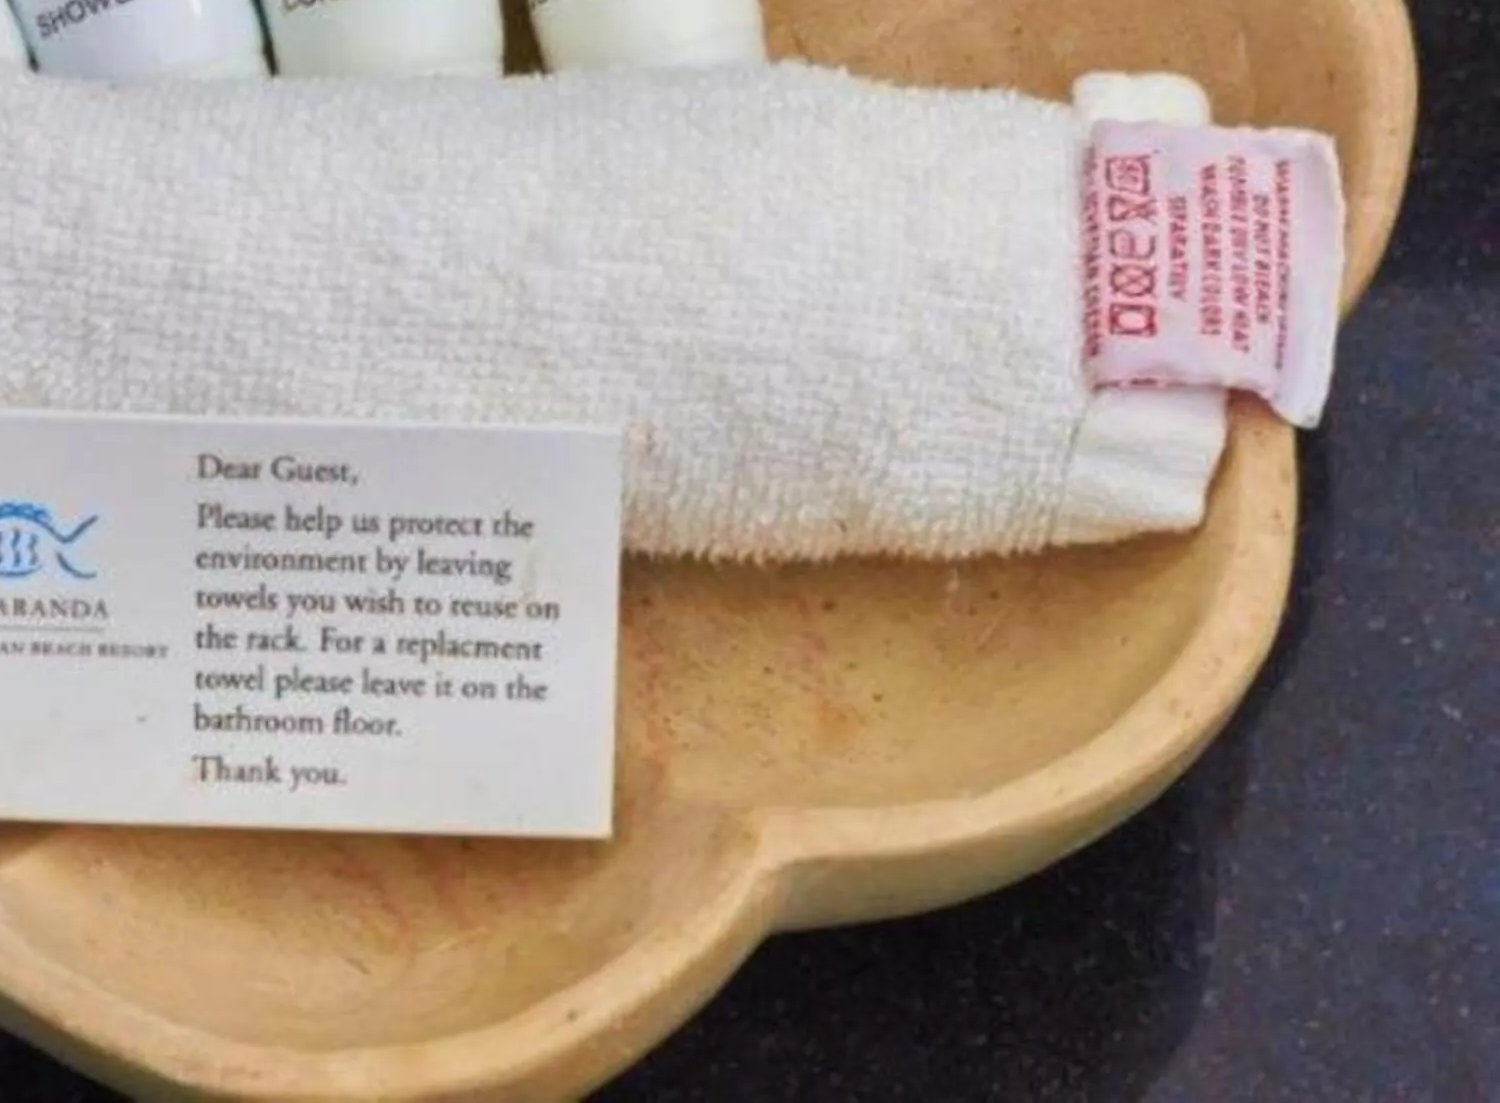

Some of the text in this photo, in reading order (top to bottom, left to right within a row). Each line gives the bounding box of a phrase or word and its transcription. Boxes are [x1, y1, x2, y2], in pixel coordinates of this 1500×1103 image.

[198, 453, 359, 486] Dear Guest,
[198, 503, 536, 542] Please help us protect the
[195, 547, 512, 585] environment by leaving
[195, 582, 561, 620] towels you wish to reuse on
[195, 624, 544, 664] the rack. For a replacment
[195, 664, 549, 701] towel please leave it on the
[193, 703, 403, 737] bathroom floor.
[192, 754, 347, 792] Thank you.
